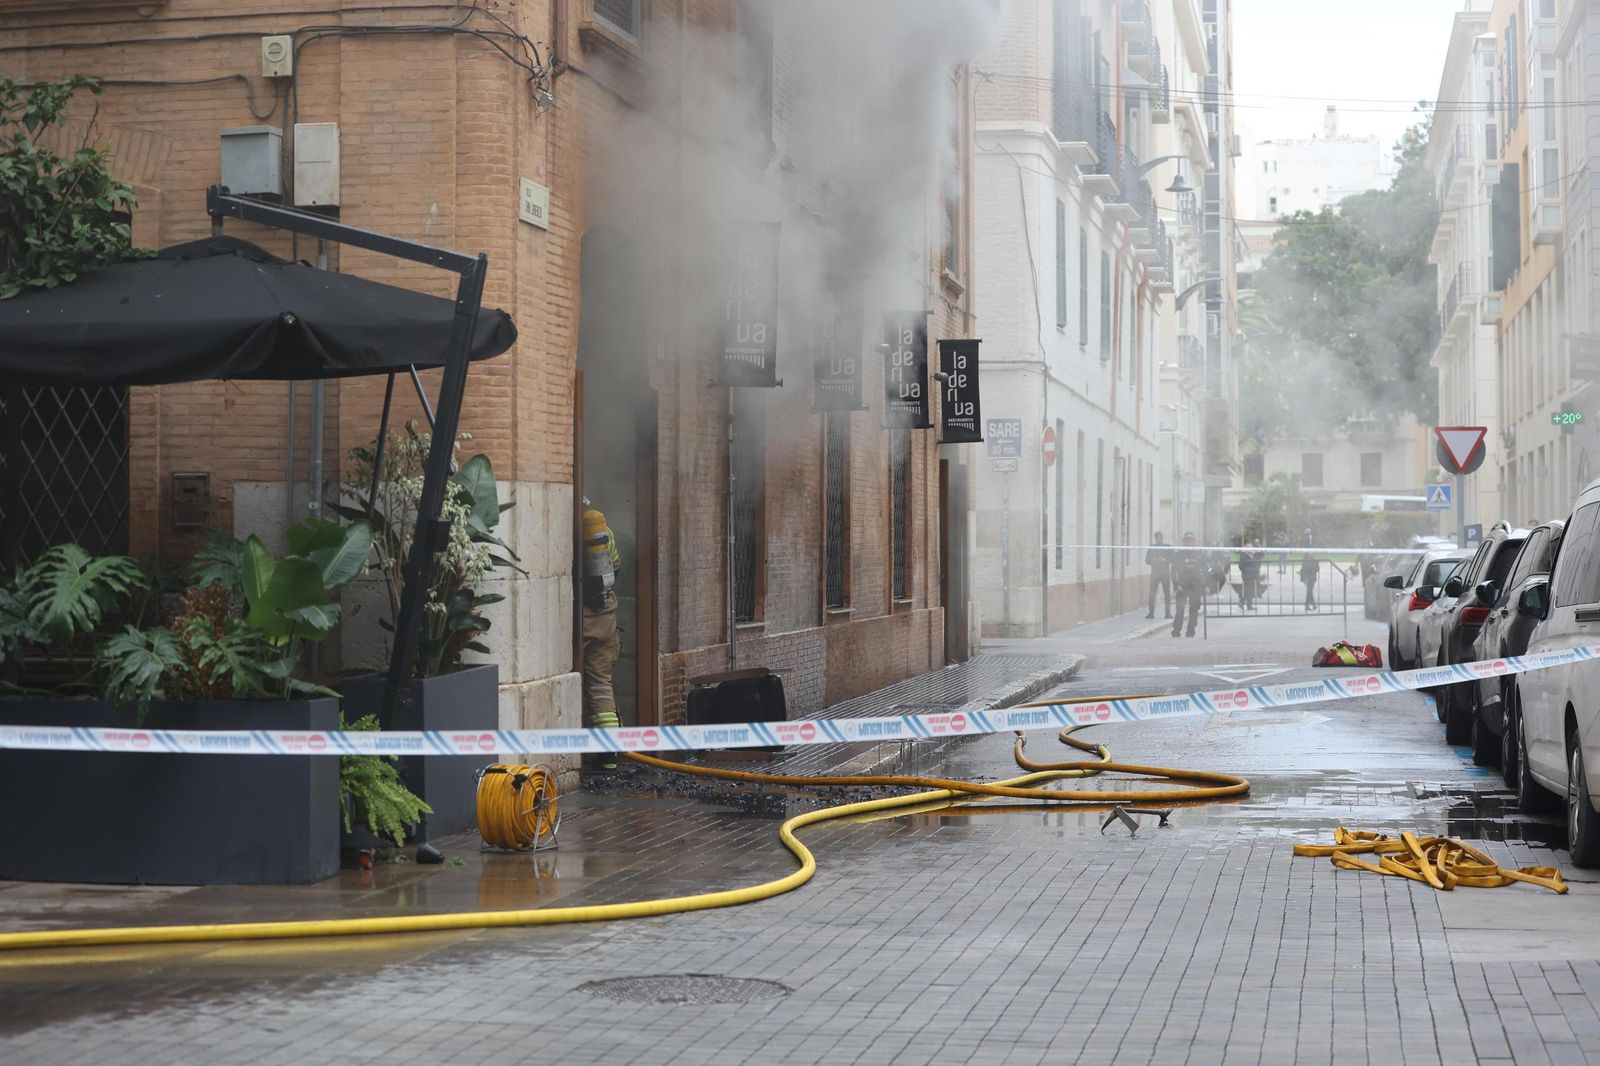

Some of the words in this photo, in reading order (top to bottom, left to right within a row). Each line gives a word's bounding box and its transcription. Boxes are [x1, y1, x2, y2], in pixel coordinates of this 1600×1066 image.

[898, 323, 913, 345] la
[892, 346, 914, 367] de
[953, 351, 967, 369] la
[948, 369, 967, 388] de
[989, 422, 1020, 438] SARE
[991, 445, 1002, 457] 30
[1468, 528, 1476, 539] P
